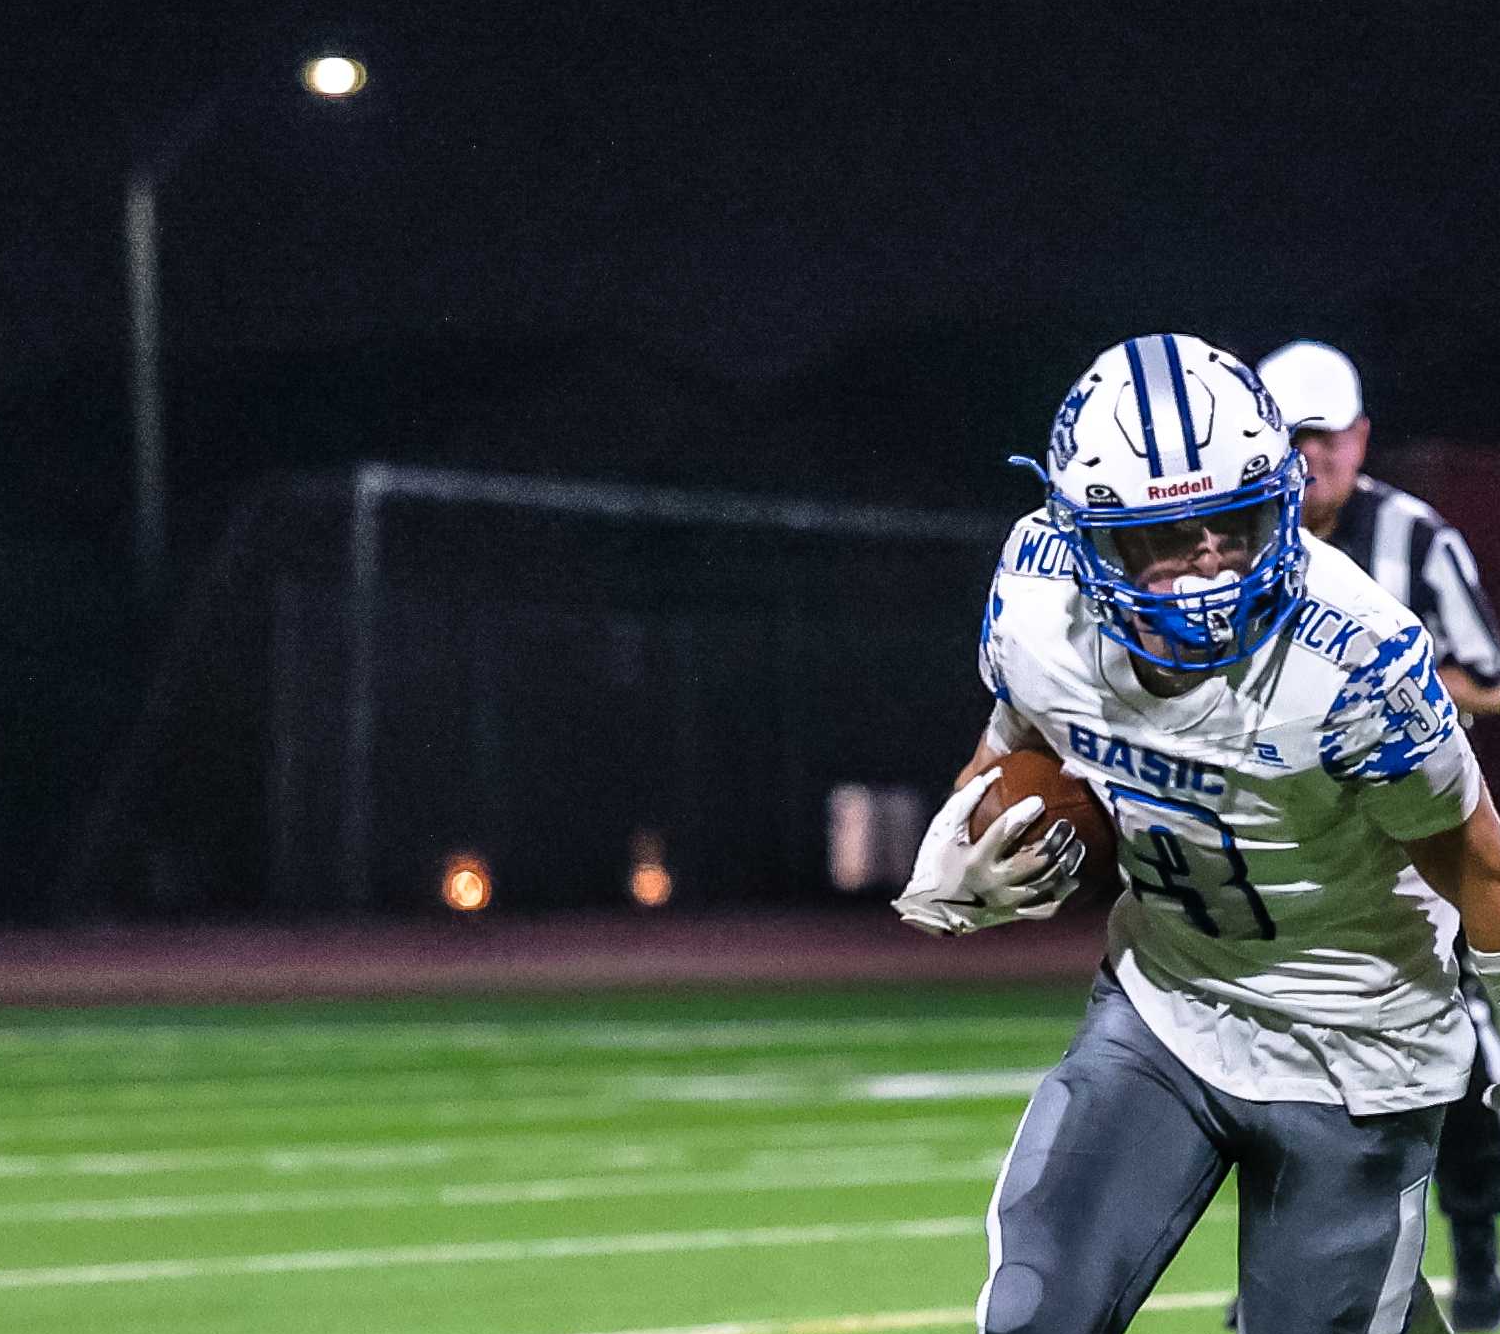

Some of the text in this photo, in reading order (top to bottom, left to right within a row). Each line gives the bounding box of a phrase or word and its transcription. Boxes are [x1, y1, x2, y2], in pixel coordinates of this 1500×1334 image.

[1147, 475, 1214, 501] Riddell
[1015, 529, 1074, 576] WOL
[1295, 599, 1364, 663] ACK
[1385, 675, 1441, 746] 3
[1068, 722, 1225, 796] BASIC
